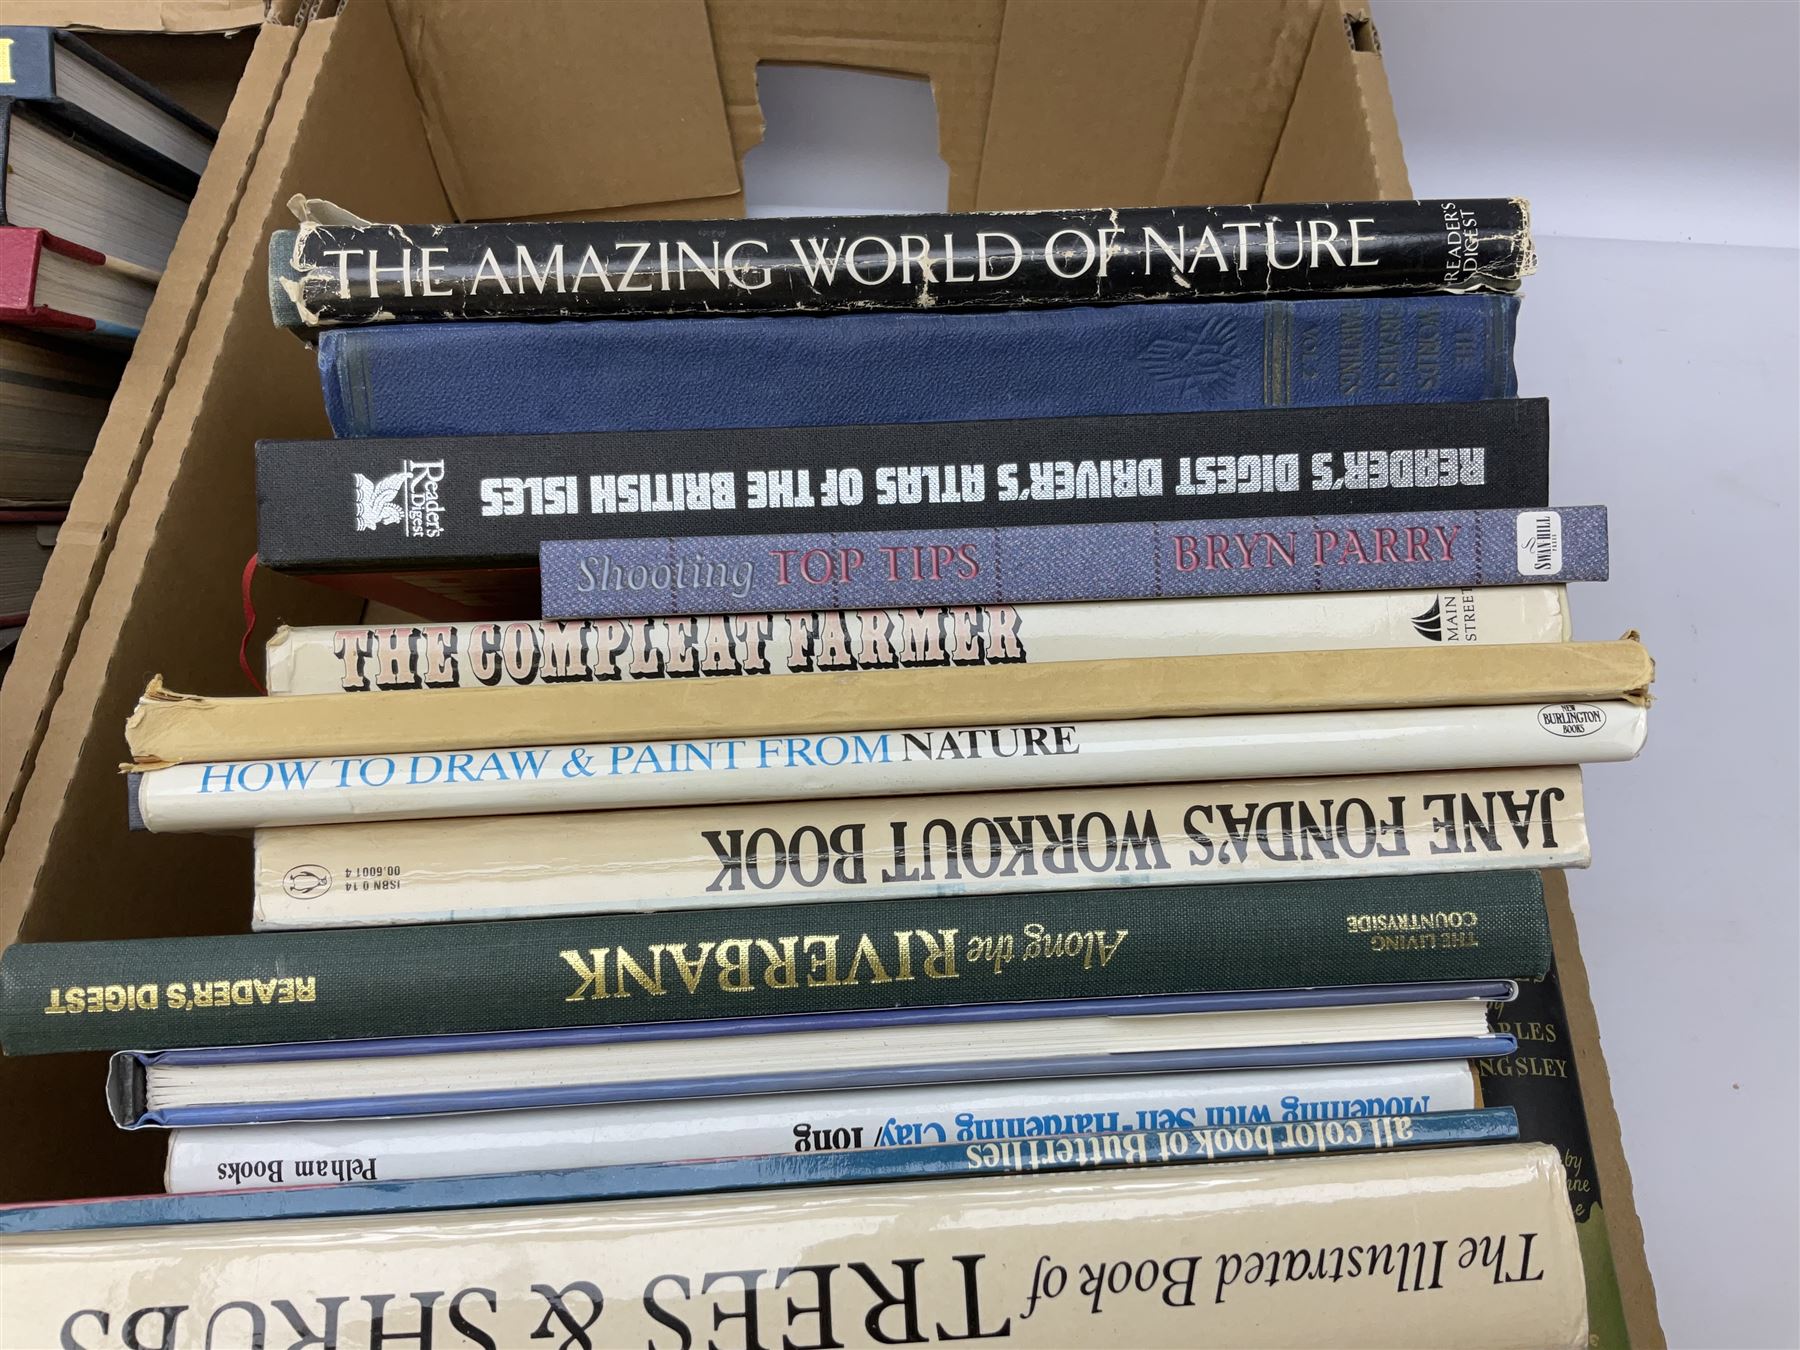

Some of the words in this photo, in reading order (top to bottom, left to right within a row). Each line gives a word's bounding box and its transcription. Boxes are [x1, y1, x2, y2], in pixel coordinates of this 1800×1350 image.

[323, 246, 454, 299] THE
[468, 240, 773, 294] AMAZING
[790, 232, 1022, 287] WORLD
[1045, 228, 1126, 280] OF
[1140, 218, 1381, 276] NATURE
[1441, 202, 1462, 281] READER'S
[1460, 209, 1480, 272] DIGEST
[748, 469, 815, 511] THE
[820, 467, 863, 509] OF
[875, 462, 986, 507] ATLAS
[997, 458, 1163, 503] DRIVER'S
[1175, 453, 1299, 496] DIGEST
[1310, 447, 1486, 490] READER'S
[410, 459, 446, 538] Reader's
[480, 475, 578, 517] ISLES
[591, 472, 737, 515] BRITISH
[409, 493, 426, 538] Digest
[1173, 530, 1297, 571] BRYN
[1312, 525, 1461, 566] PARRY
[578, 554, 756, 598] Shooting
[768, 546, 865, 585] TOP
[879, 543, 980, 582] TIPS
[1444, 596, 1459, 641] MAIN
[1461, 587, 1477, 641] STREET
[333, 625, 460, 692] THE
[467, 615, 774, 686] COMPLEAT
[786, 603, 1028, 673] FARMER
[1542, 711, 1602, 725] BURLINGTON
[1562, 724, 1585, 734] BOOKS
[198, 763, 322, 793] HOW
[331, 757, 396, 788] TO
[406, 749, 553, 785] DRAW
[562, 747, 597, 779] &
[610, 740, 746, 775] PAINT
[756, 733, 893, 770] FROM
[902, 726, 1080, 762] NATURE
[1183, 793, 1411, 868] FONDA'S
[1424, 786, 1566, 854] JANE
[700, 823, 867, 893] BOOK
[882, 808, 1172, 884] WORKOUT
[344, 881, 358, 892] 14
[373, 879, 401, 891] ISBN
[1346, 911, 1478, 933] COUNTRYSIDE
[1369, 933, 1437, 951] LIVING
[1441, 931, 1479, 948] THE
[558, 929, 960, 1003] RIVERBANK
[966, 931, 1014, 974] the
[1023, 923, 1129, 970] Along
[45, 983, 159, 1015] DIGEST
[166, 976, 318, 1010] READER'S
[1480, 1056, 1568, 1078] NGSLEY
[966, 1132, 1148, 1171] Butterflies
[1158, 1130, 1188, 1162] of
[1198, 1124, 1276, 1159] book
[1283, 1120, 1363, 1152] color
[1369, 1116, 1413, 1148] all
[217, 1159, 283, 1182] Books
[295, 1157, 378, 1181] Pelham
[1564, 1148, 1583, 1178] by
[1214, 1239, 1449, 1304] Illustrated
[1458, 1232, 1545, 1284] The
[642, 1253, 1012, 1350] TREES
[1020, 1255, 1068, 1320] of
[1079, 1254, 1202, 1314] Book
[529, 1279, 606, 1350] &
